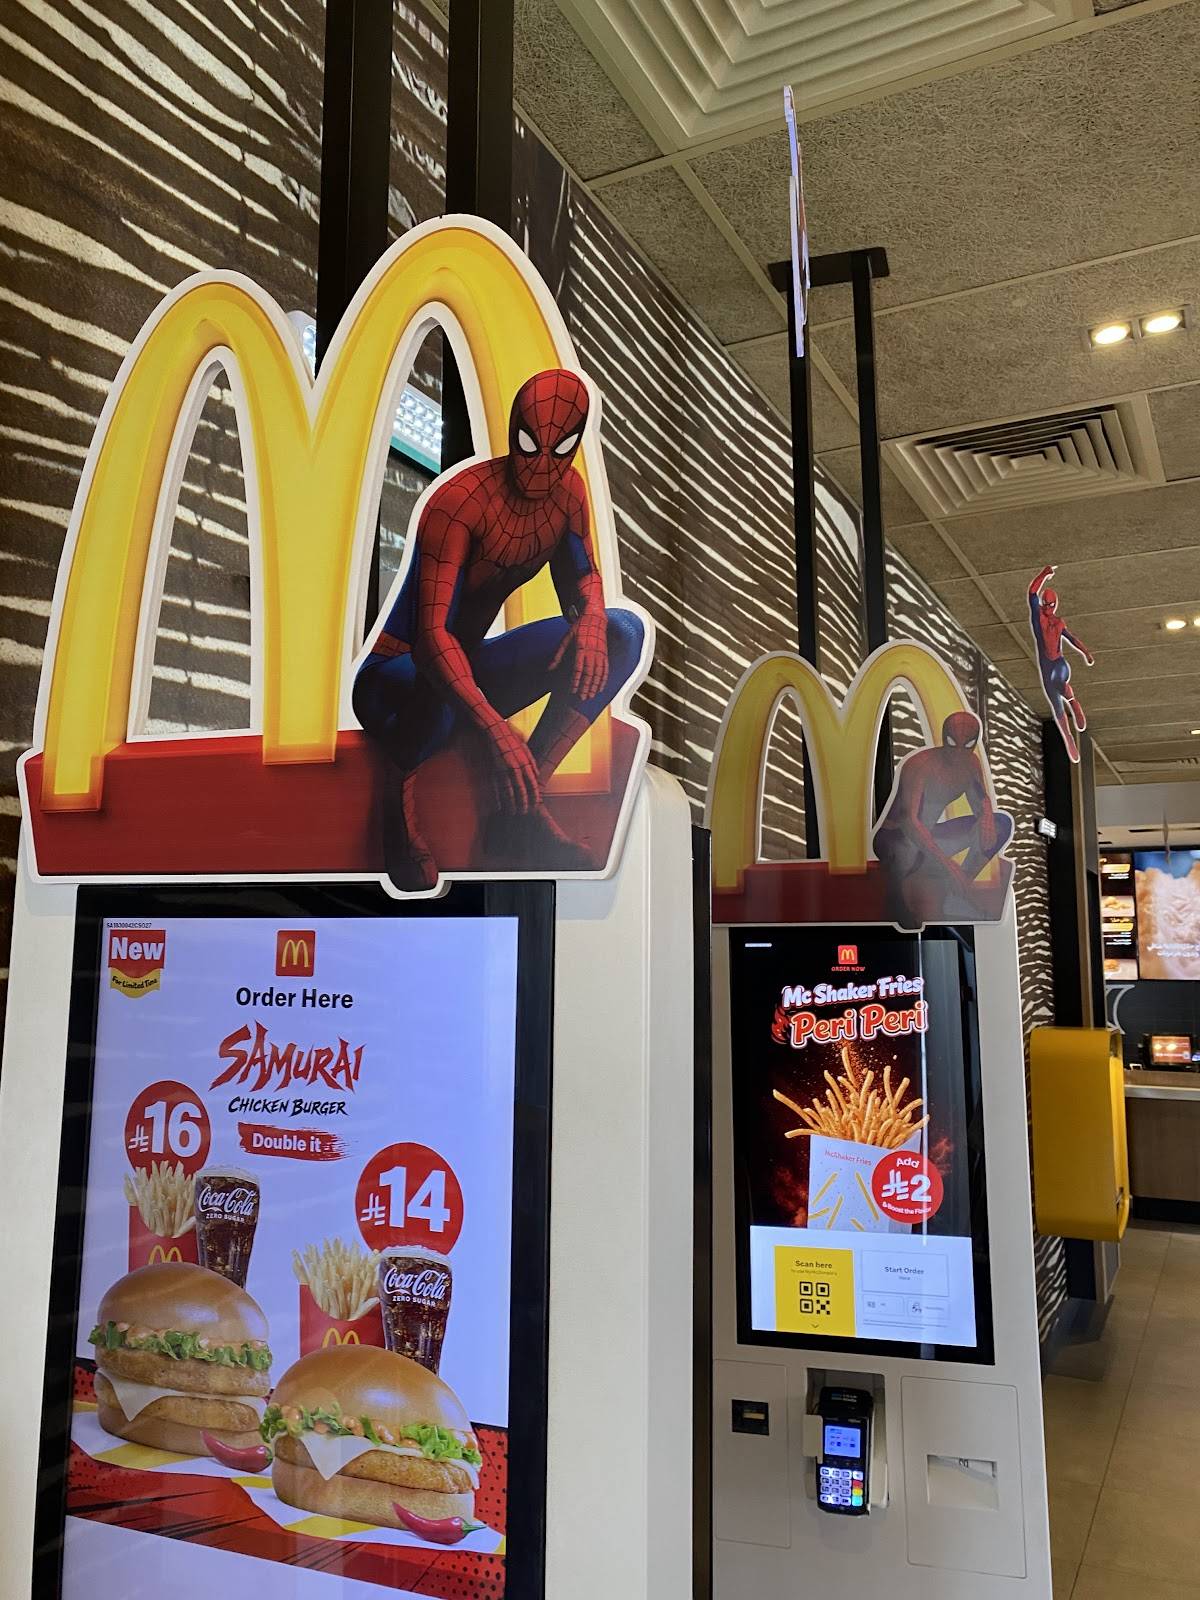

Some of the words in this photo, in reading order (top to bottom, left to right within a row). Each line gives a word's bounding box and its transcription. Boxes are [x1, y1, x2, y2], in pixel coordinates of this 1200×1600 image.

[111, 936, 164, 961] New
[236, 987, 297, 1007] Order
[301, 988, 354, 1009] Here
[783, 985, 812, 1008] Mc
[813, 982, 876, 1005] Shaker
[877, 974, 924, 998] Fries
[791, 1009, 858, 1048] Peri
[860, 1001, 928, 1040] Peri
[208, 1020, 367, 1095] SAMURAI
[228, 1096, 290, 1115] CHICKEN
[290, 1098, 349, 1118] BURGER
[252, 1132, 307, 1152] Double
[310, 1135, 322, 1153] it
[896, 1157, 920, 1169] Add
[199, 1183, 256, 1216] Coca-Cola
[223, 1214, 245, 1223] SUGAR
[815, 1261, 832, 1269] here
[384, 1264, 448, 1299] Coca-Cola
[412, 1297, 436, 1307] SUGAR
